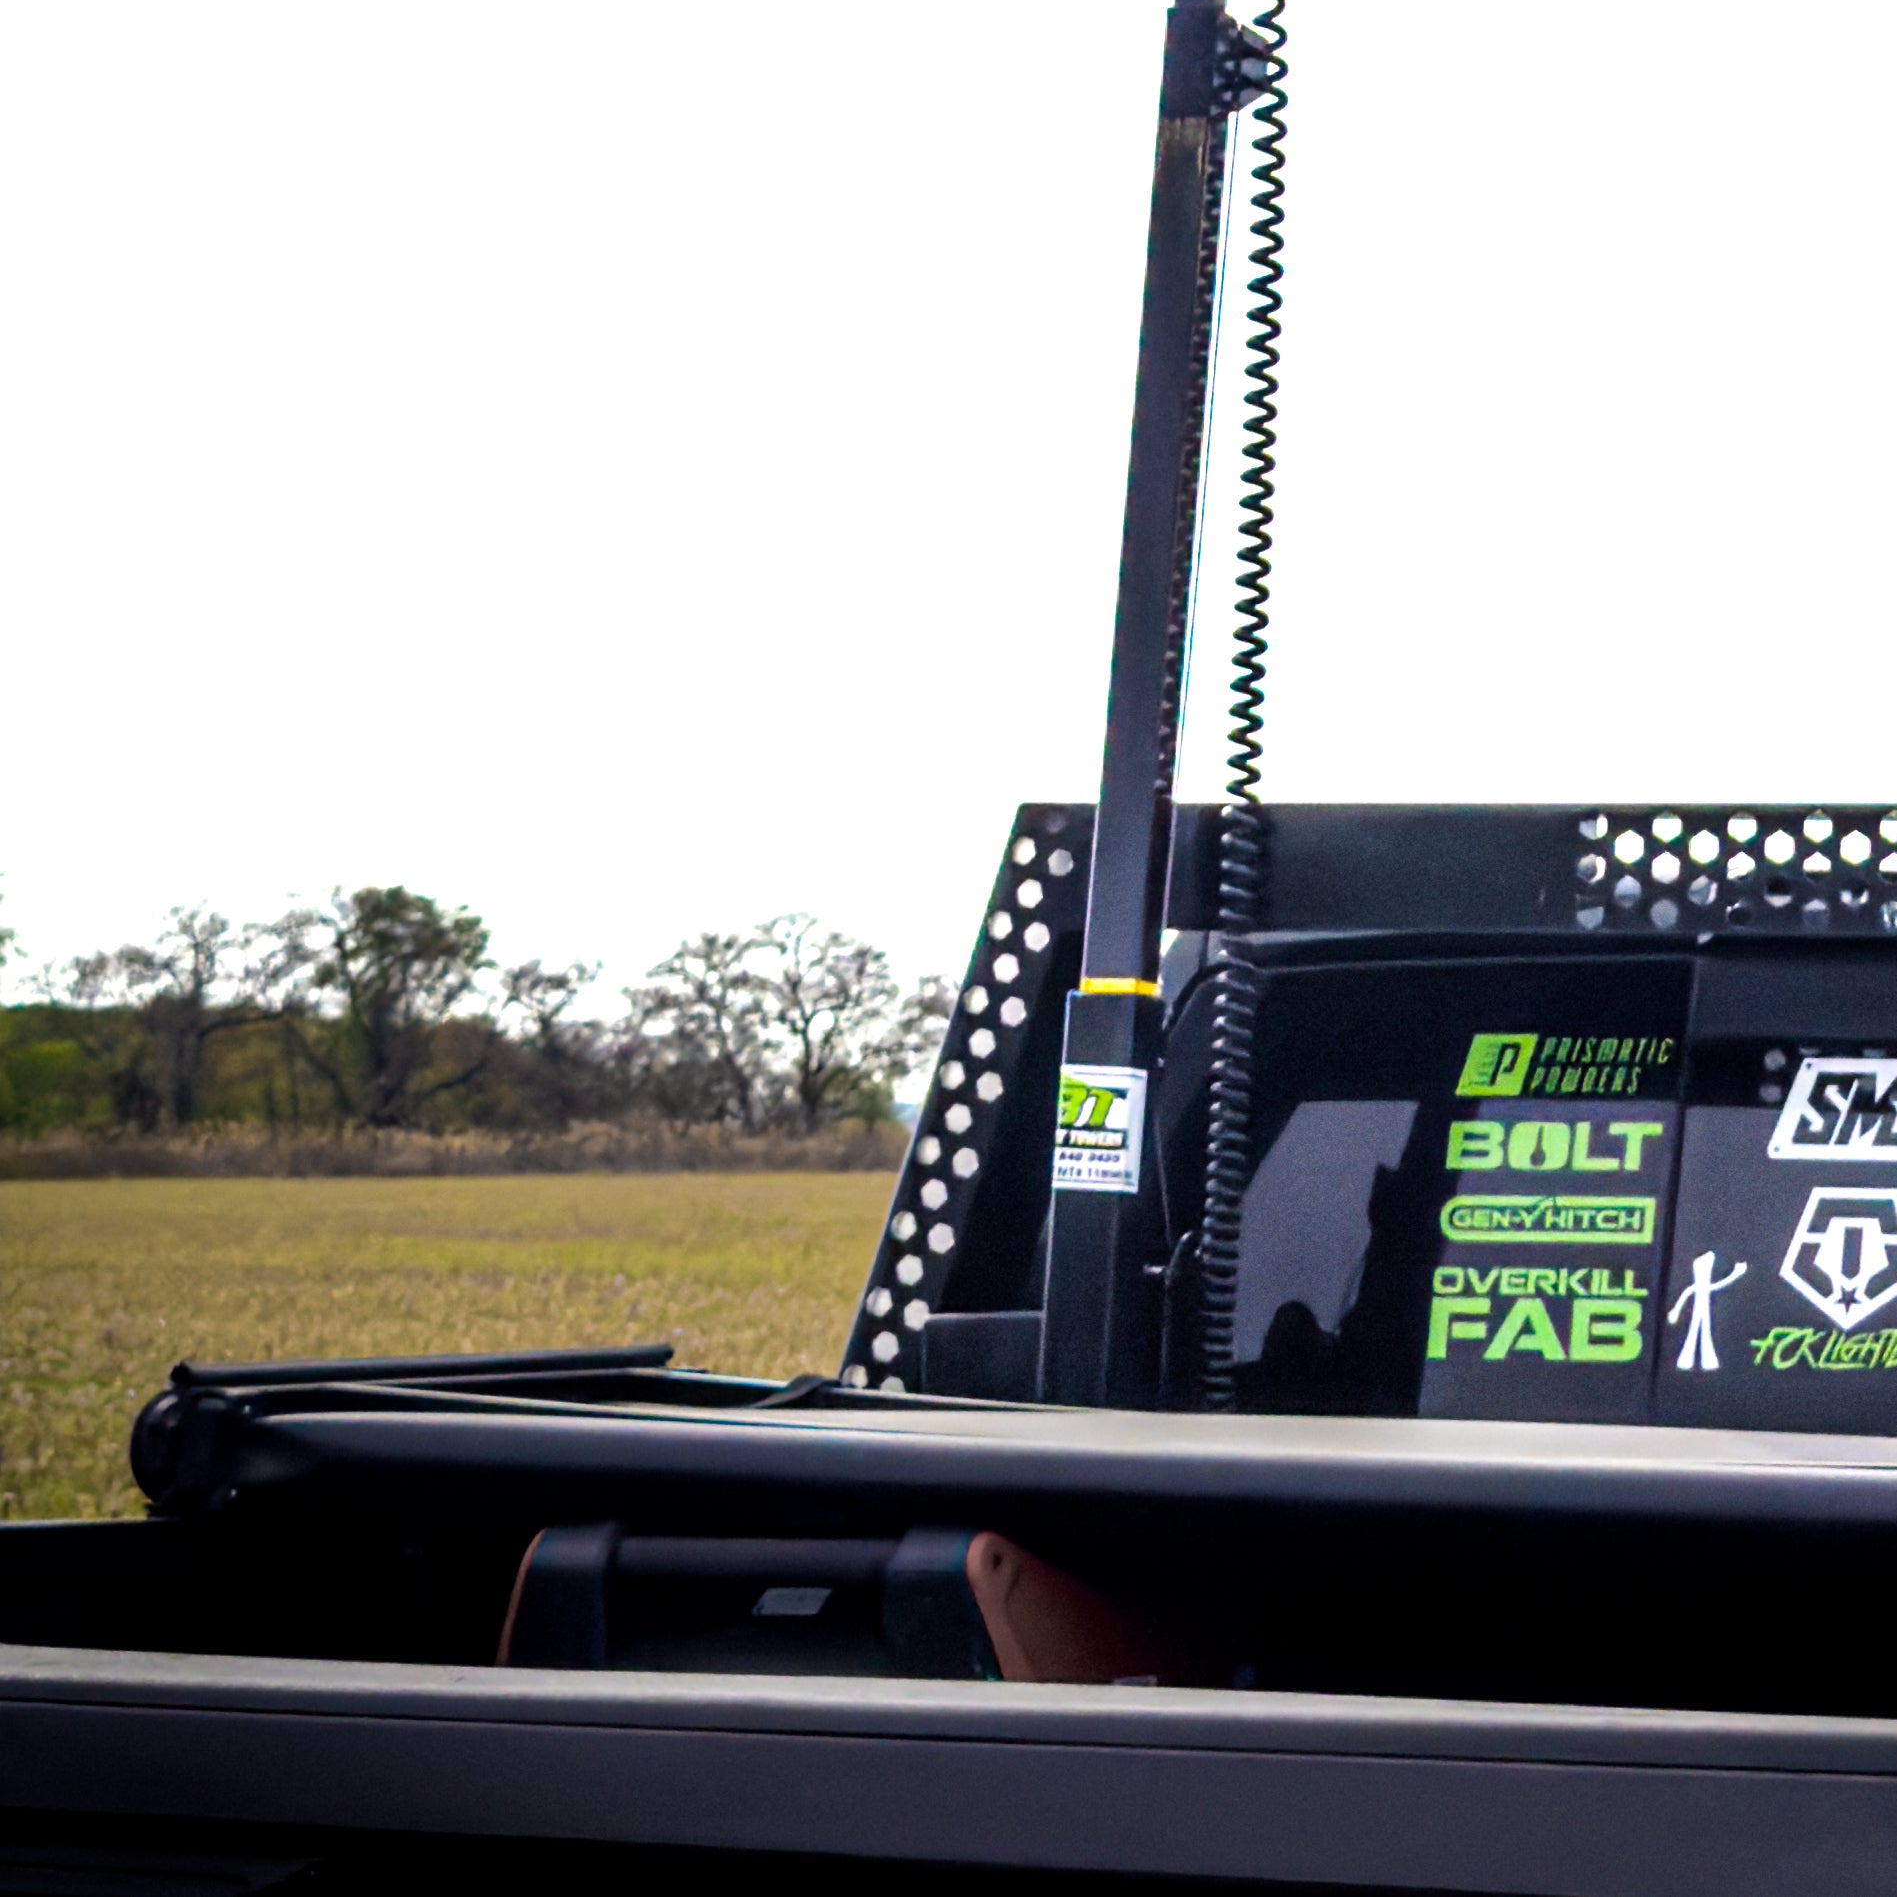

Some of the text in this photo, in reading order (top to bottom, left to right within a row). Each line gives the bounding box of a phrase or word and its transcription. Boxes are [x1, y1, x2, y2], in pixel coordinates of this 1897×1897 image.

[1540, 1036, 1676, 1064] PRISMATIC
[1530, 1066, 1643, 1095] POWDERS
[1446, 1120, 1663, 1172] BOLT
[1451, 1208, 1642, 1232] GEN-Y HITCH
[1432, 1266, 1649, 1297] OVERKILL
[1426, 1296, 1644, 1363] FAB
